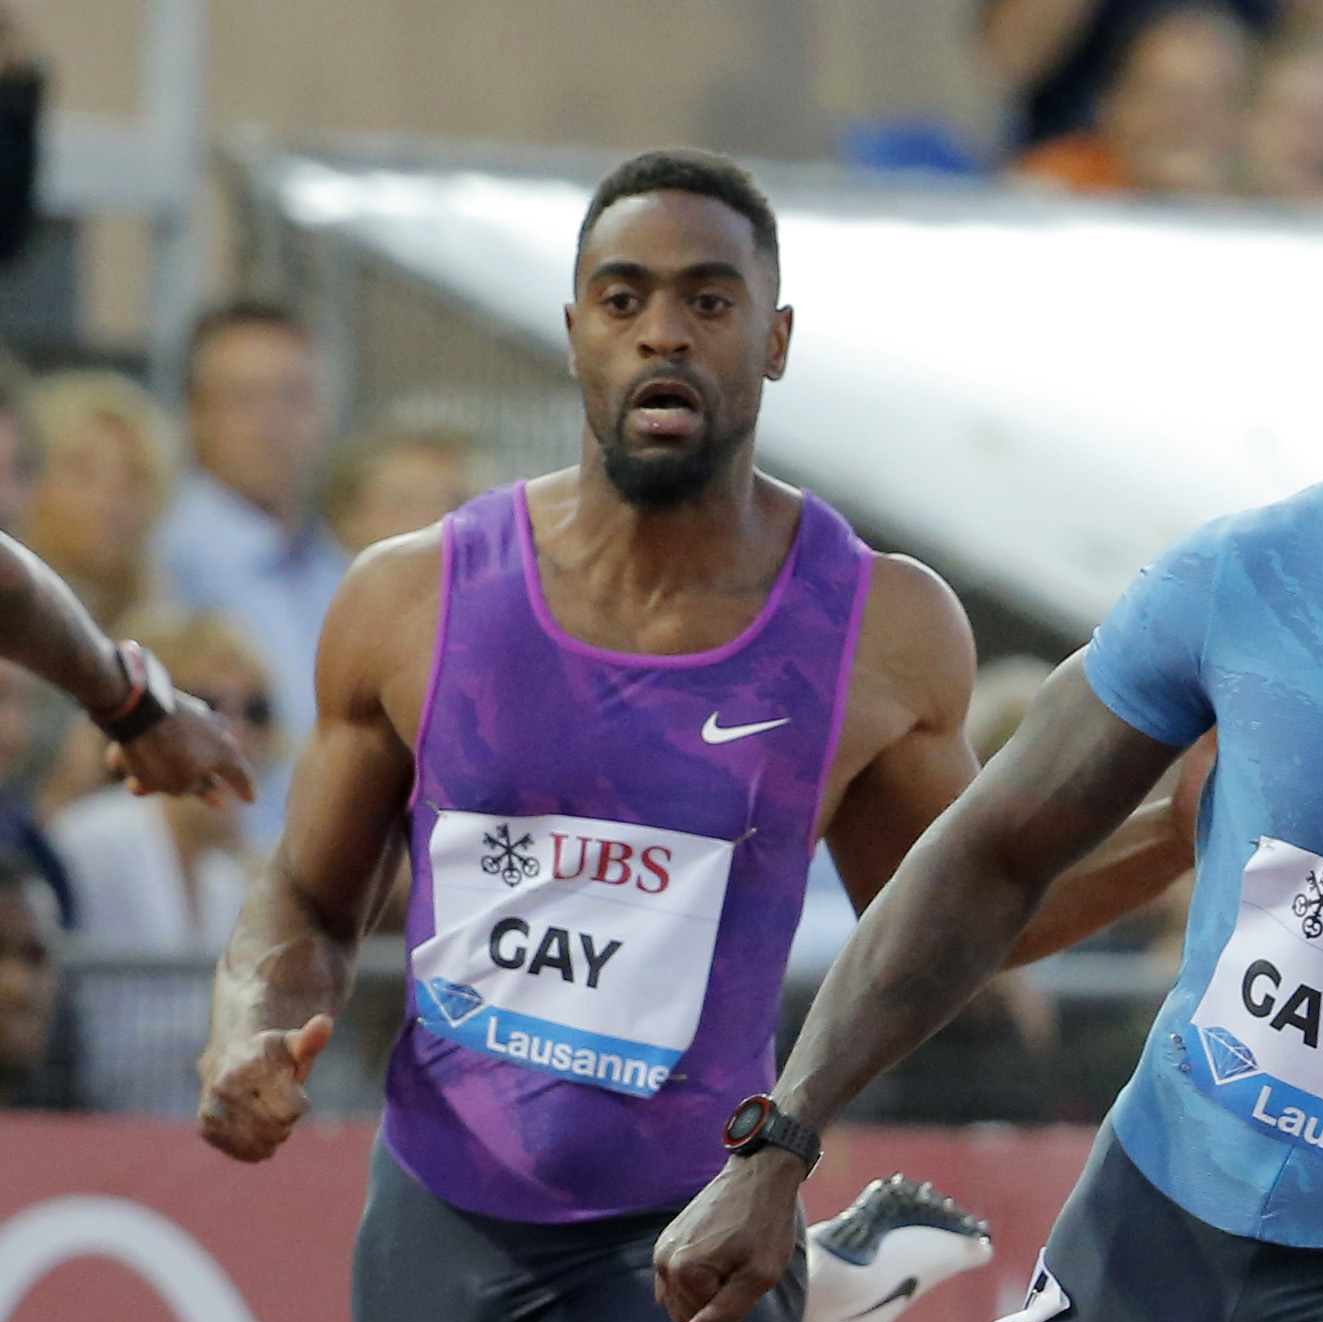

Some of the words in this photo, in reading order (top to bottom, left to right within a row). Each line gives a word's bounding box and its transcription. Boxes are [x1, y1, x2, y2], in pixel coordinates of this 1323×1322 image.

[551, 832, 673, 895] UBS
[489, 917, 625, 989] GAY
[486, 1016, 671, 1091] Lausanne
